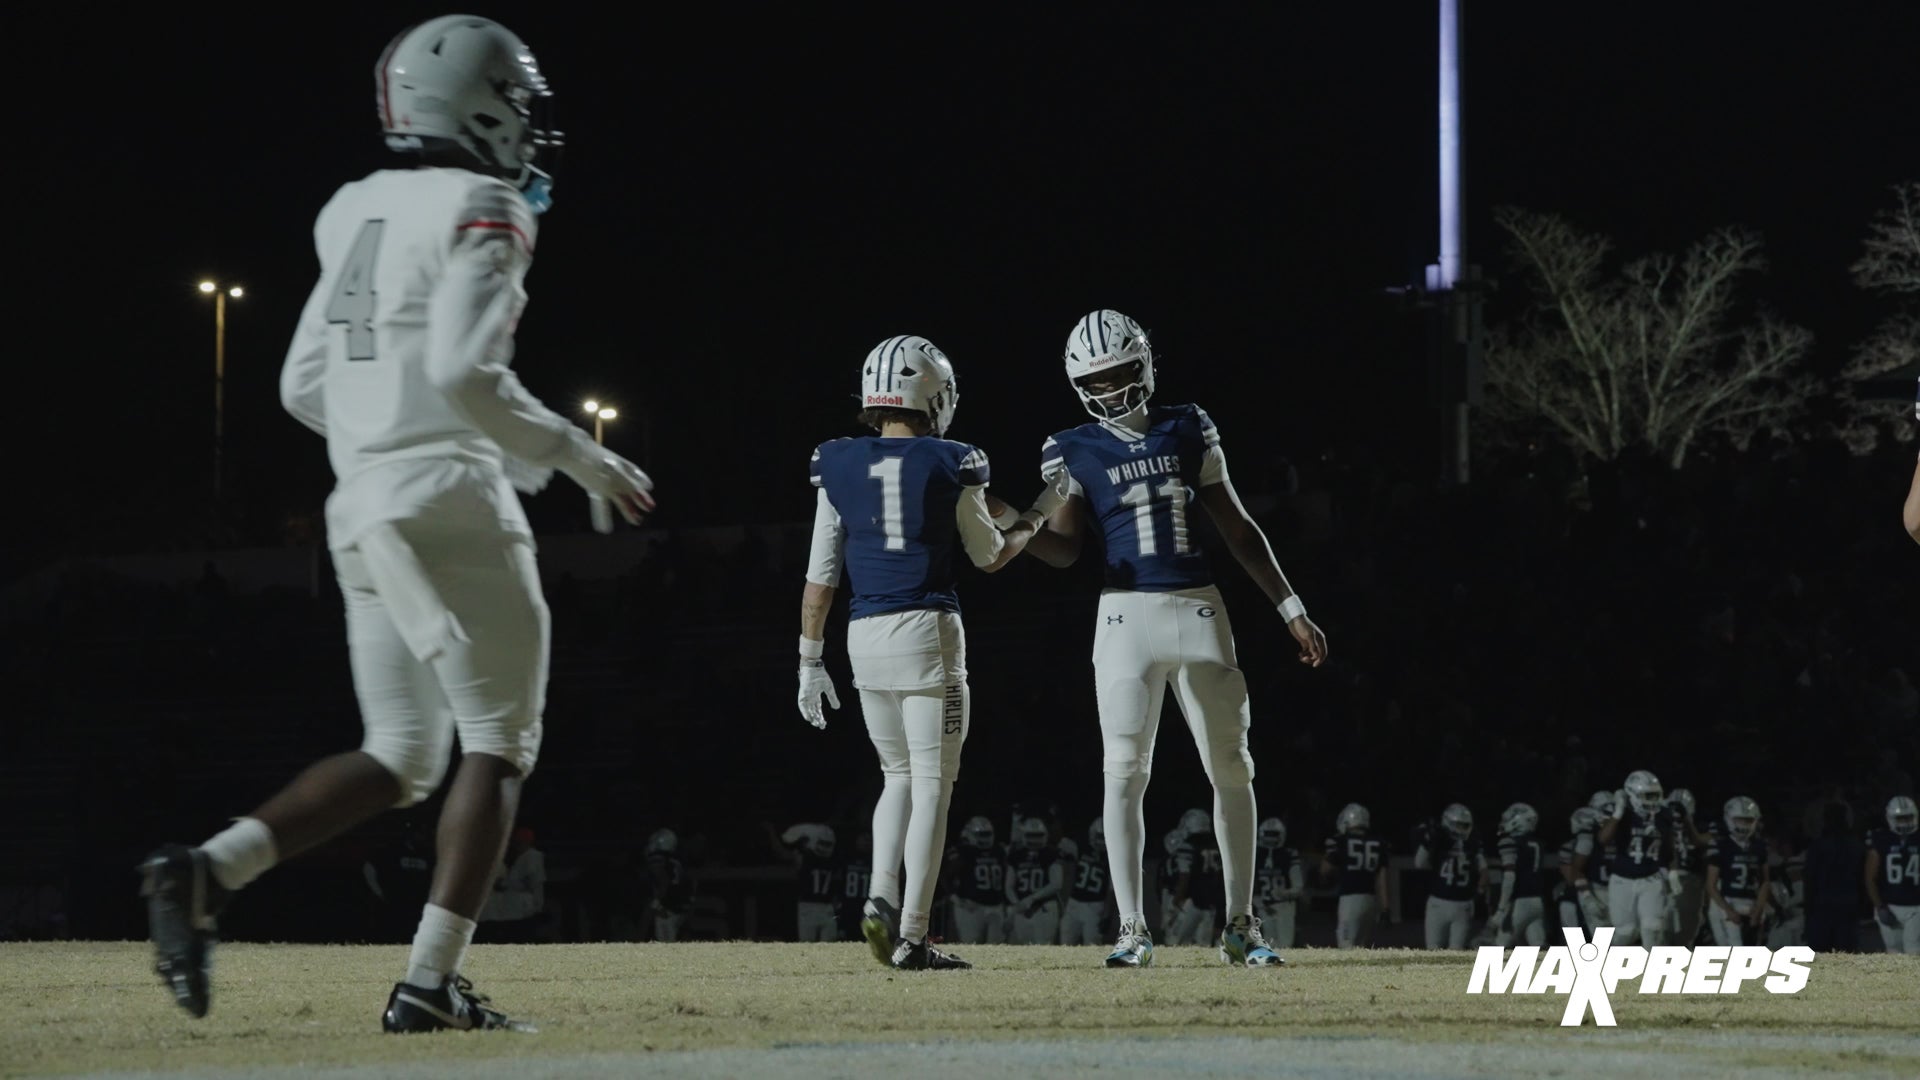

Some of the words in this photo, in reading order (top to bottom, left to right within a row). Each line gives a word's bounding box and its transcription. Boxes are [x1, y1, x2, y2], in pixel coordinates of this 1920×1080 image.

[326, 219, 385, 361] 4
[1089, 355, 1115, 368] Riddell
[867, 395, 903, 406] Riddell
[1106, 456, 1180, 485] WHIRLIES
[867, 456, 914, 552] 1
[1119, 477, 1190, 557] 11
[945, 682, 962, 734] HIRLIES
[1346, 838, 1382, 872] 56
[1527, 841, 1541, 873] 7
[1628, 836, 1662, 865] 44
[811, 868, 832, 896] 17
[1075, 860, 1106, 894] 35
[1439, 856, 1471, 888] 45
[1886, 853, 1920, 887] 64
